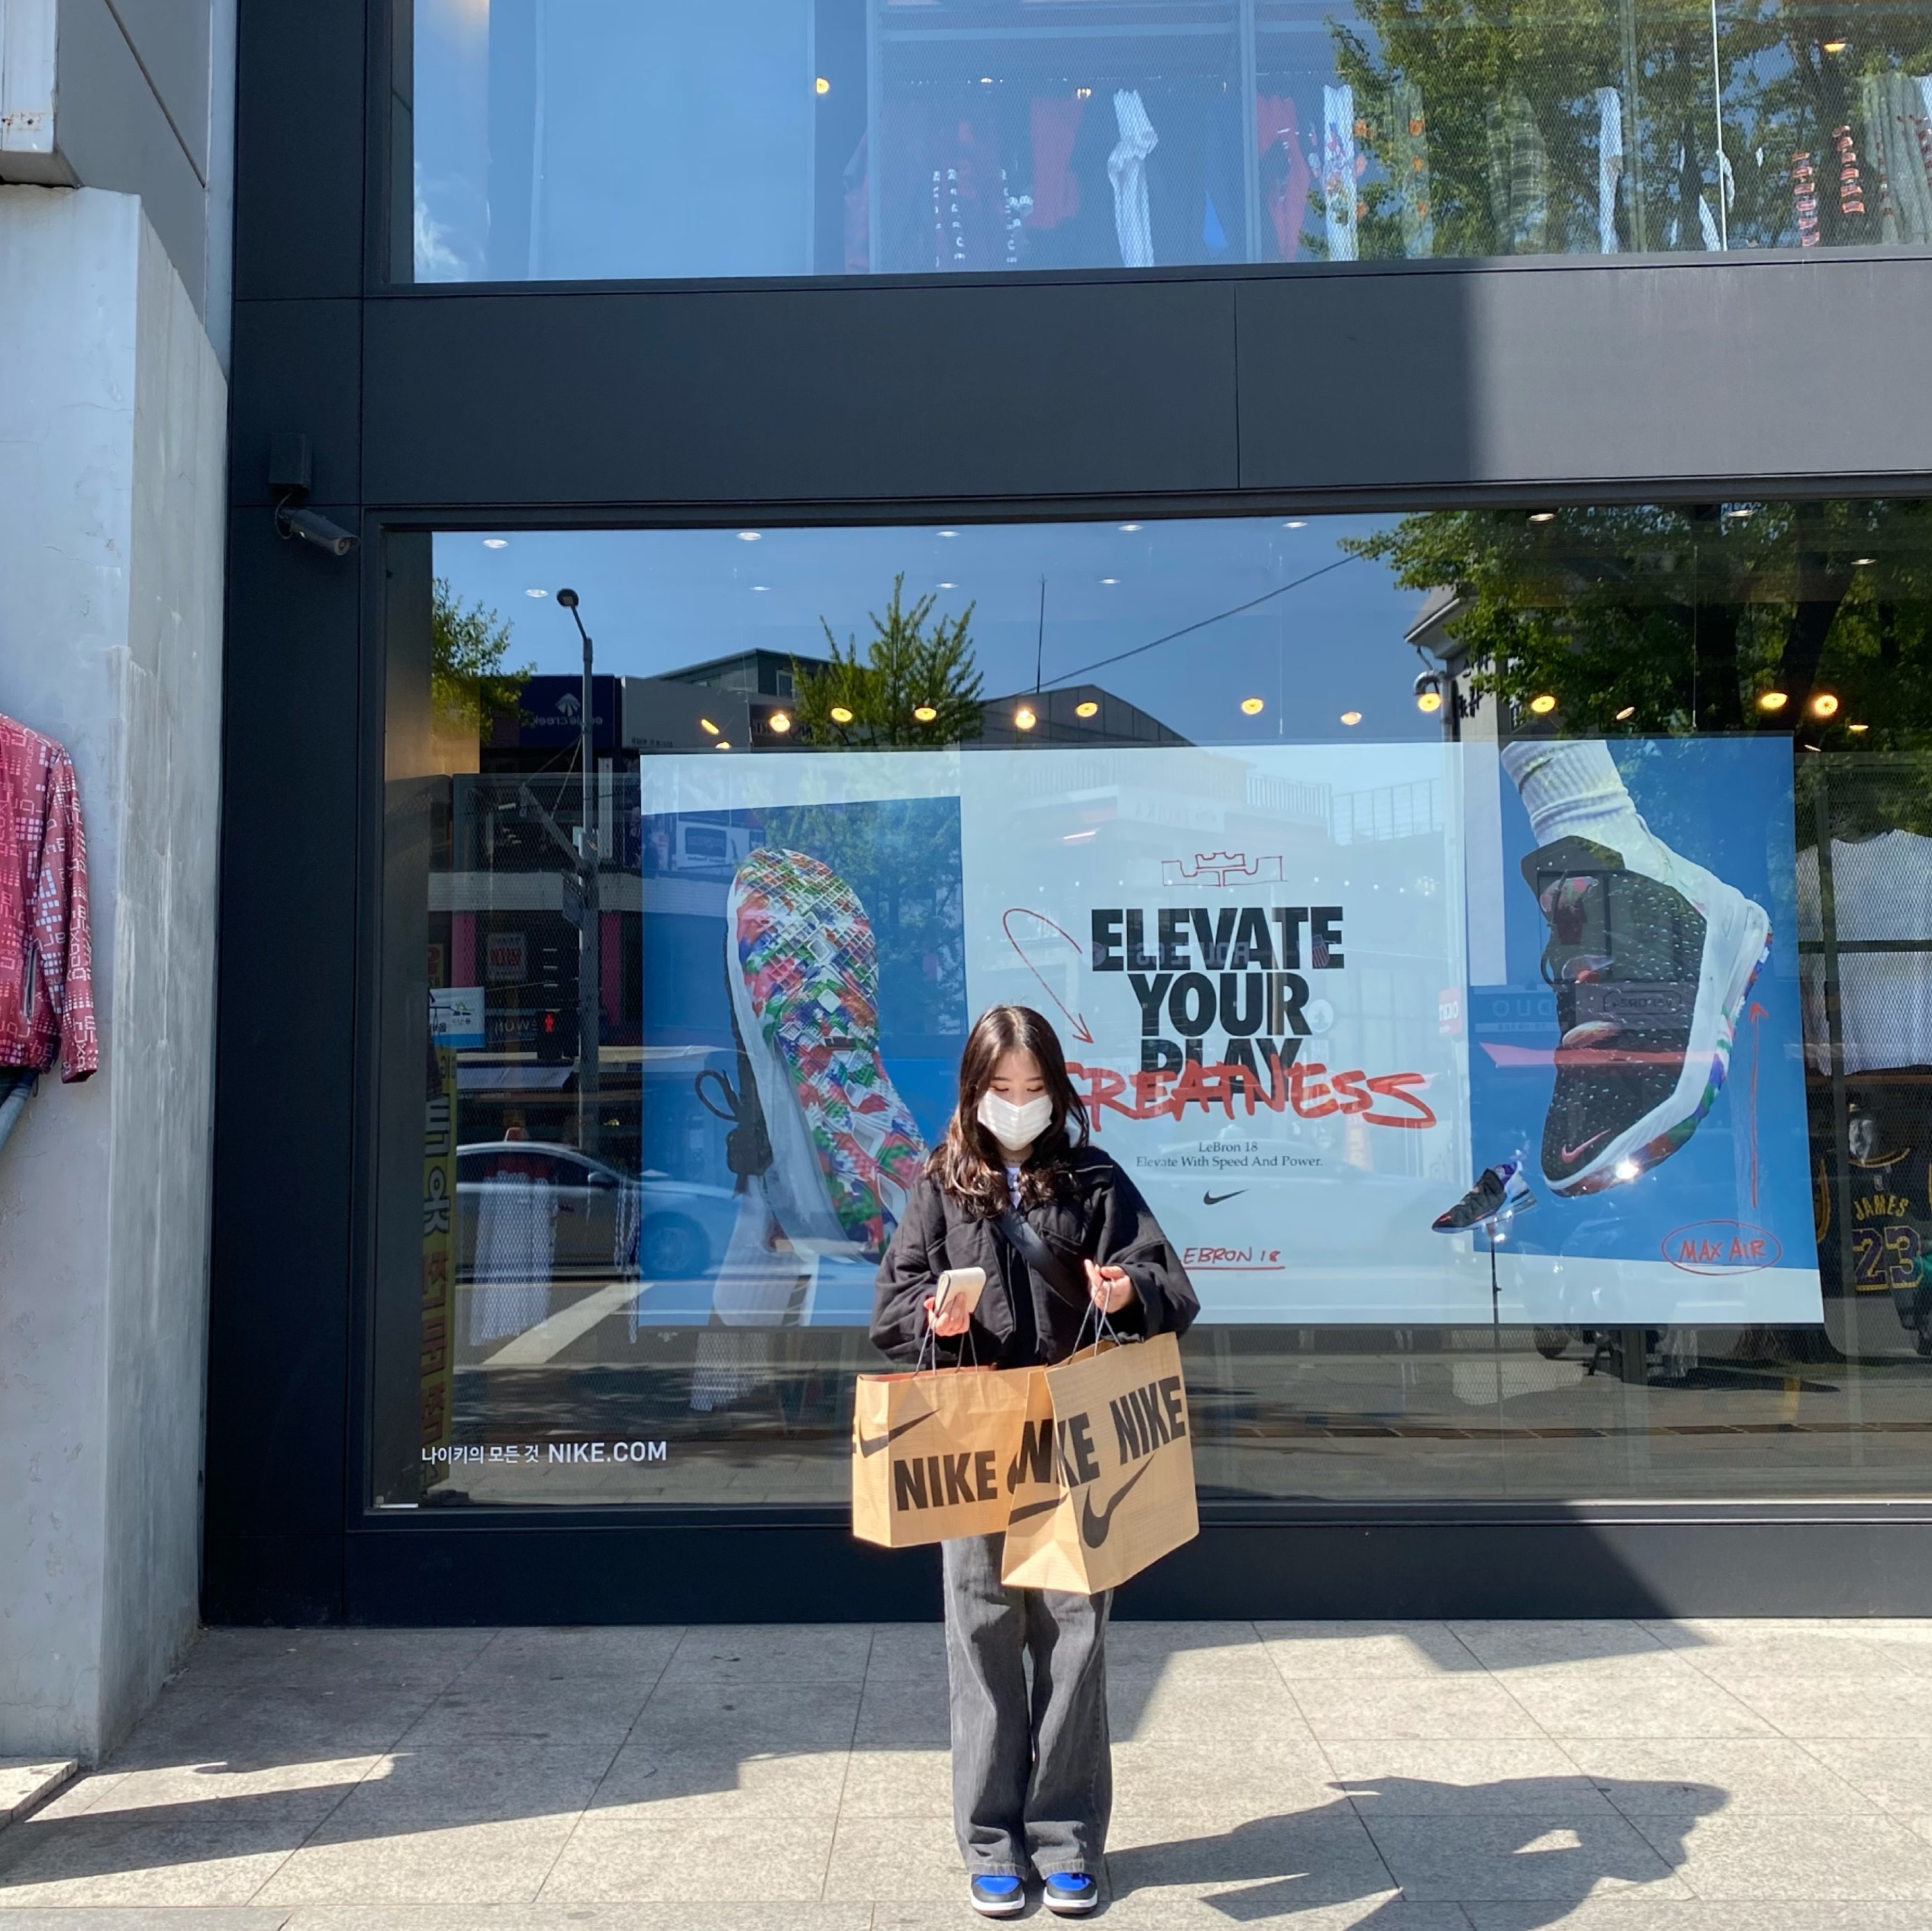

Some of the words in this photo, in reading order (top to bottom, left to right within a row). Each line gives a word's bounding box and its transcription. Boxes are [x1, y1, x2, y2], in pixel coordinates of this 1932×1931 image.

[1090, 906, 1344, 971] ELEVATE
[1126, 972, 1312, 1037] YOUR
[1136, 1156, 1178, 1167] Elevate
[1181, 1155, 1209, 1167] With
[1212, 1155, 1248, 1171] Speed
[1251, 1156, 1278, 1167] And
[1281, 1155, 1323, 1167] Power.
[1199, 1142, 1241, 1153] LeBron
[1245, 1142, 1258, 1152] 18
[1854, 1194, 1908, 1221] JAMES
[1181, 1246, 1252, 1264] EBRON
[1679, 1239, 1721, 1263] MAX
[1729, 1235, 1766, 1261] AIR
[1851, 1225, 1924, 1292] 23
[1109, 1376, 1186, 1466] NIKE
[422, 1446, 484, 1465] 나이키의
[488, 1445, 520, 1464] 모든
[524, 1445, 540, 1464] 것
[549, 1441, 667, 1464] NIKE.COM
[1016, 1412, 1101, 1488] NKE
[893, 1450, 998, 1512] NIKE
